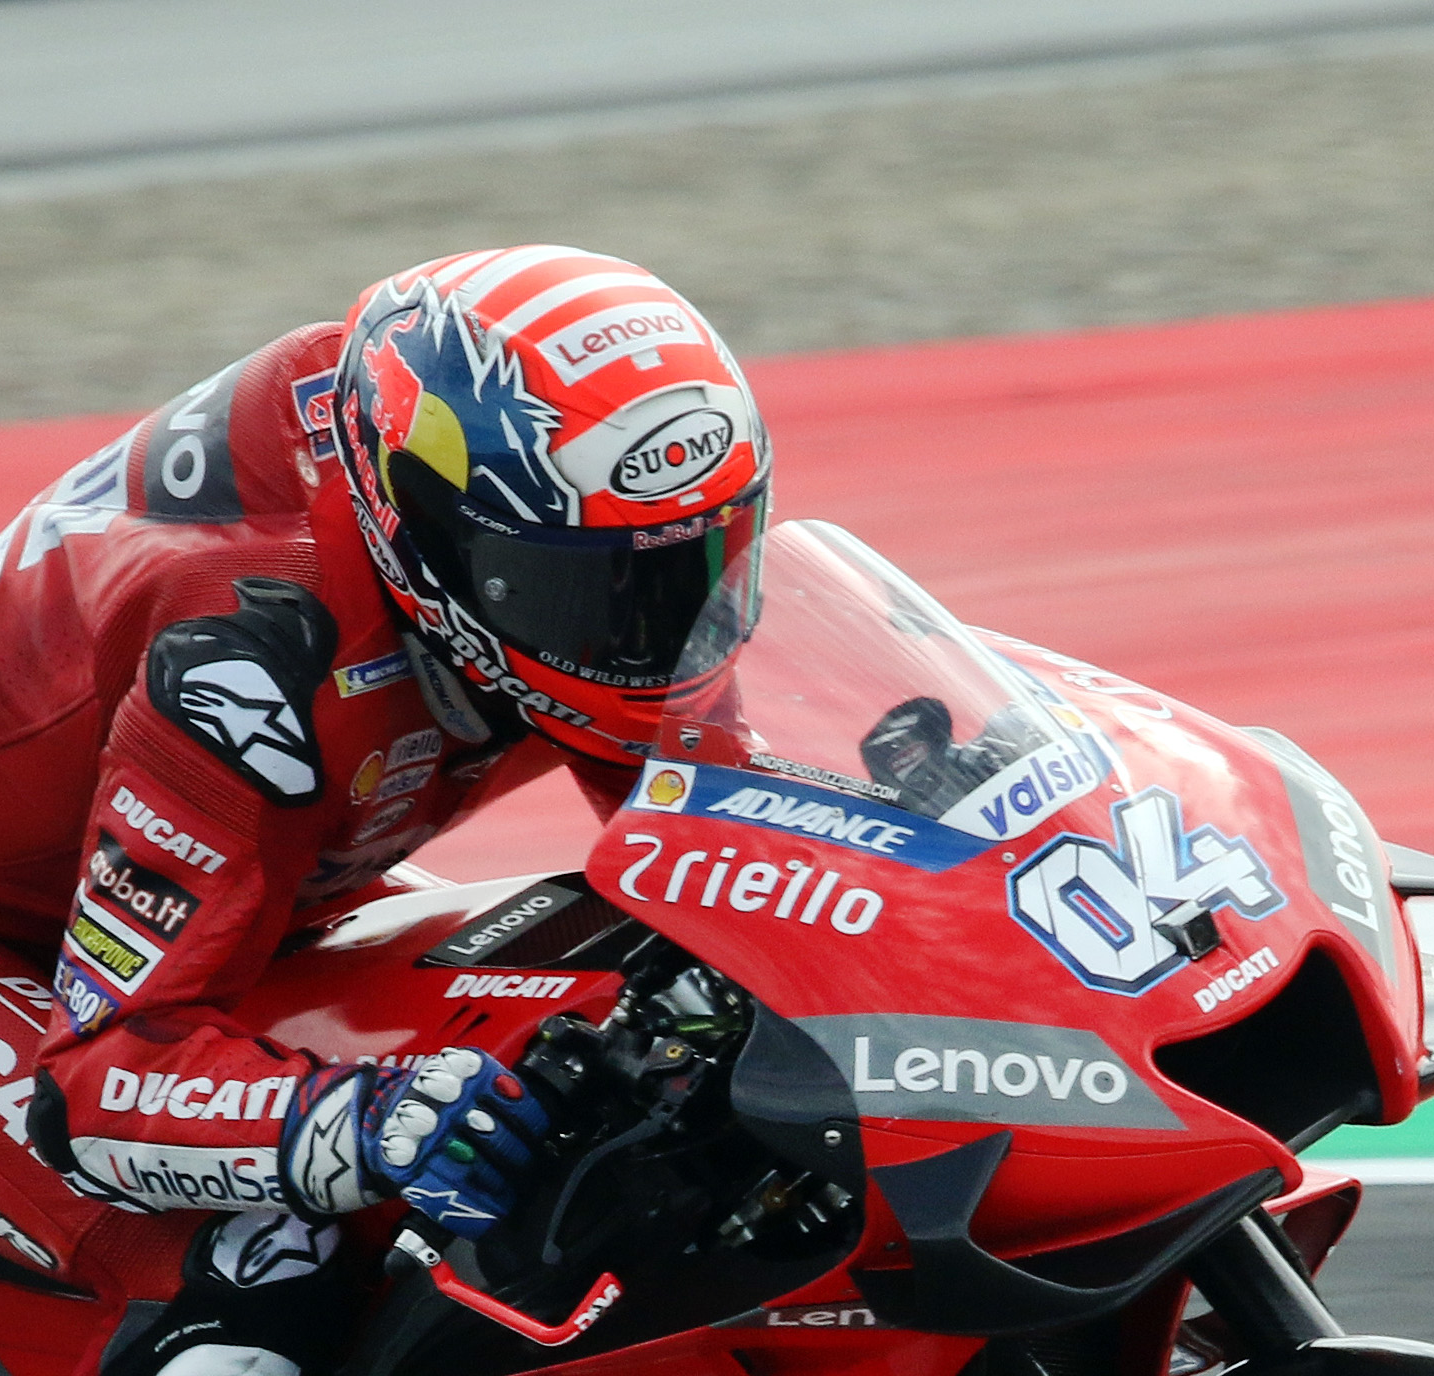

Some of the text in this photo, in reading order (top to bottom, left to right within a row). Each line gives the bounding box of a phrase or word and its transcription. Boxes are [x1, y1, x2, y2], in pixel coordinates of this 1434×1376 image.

[556, 311, 684, 365] Lenovo
[623, 426, 730, 480] SUOMY
[449, 634, 593, 727] DUCATI
[538, 650, 575, 673] OLD
[578, 662, 626, 687] WILD
[110, 785, 228, 875] DUCATI
[707, 786, 915, 854] ADVANCE
[664, 847, 884, 936] riello
[1006, 785, 1288, 997] 04
[447, 895, 554, 957] Lenovo
[443, 974, 577, 999] DUCATI
[1193, 946, 1280, 1014] DUCATI
[99, 1066, 297, 1121] DUCATI
[853, 1036, 1128, 1104] Lenovo
[108, 1153, 287, 1205] UnipolSa
[767, 1308, 876, 1326] Len
